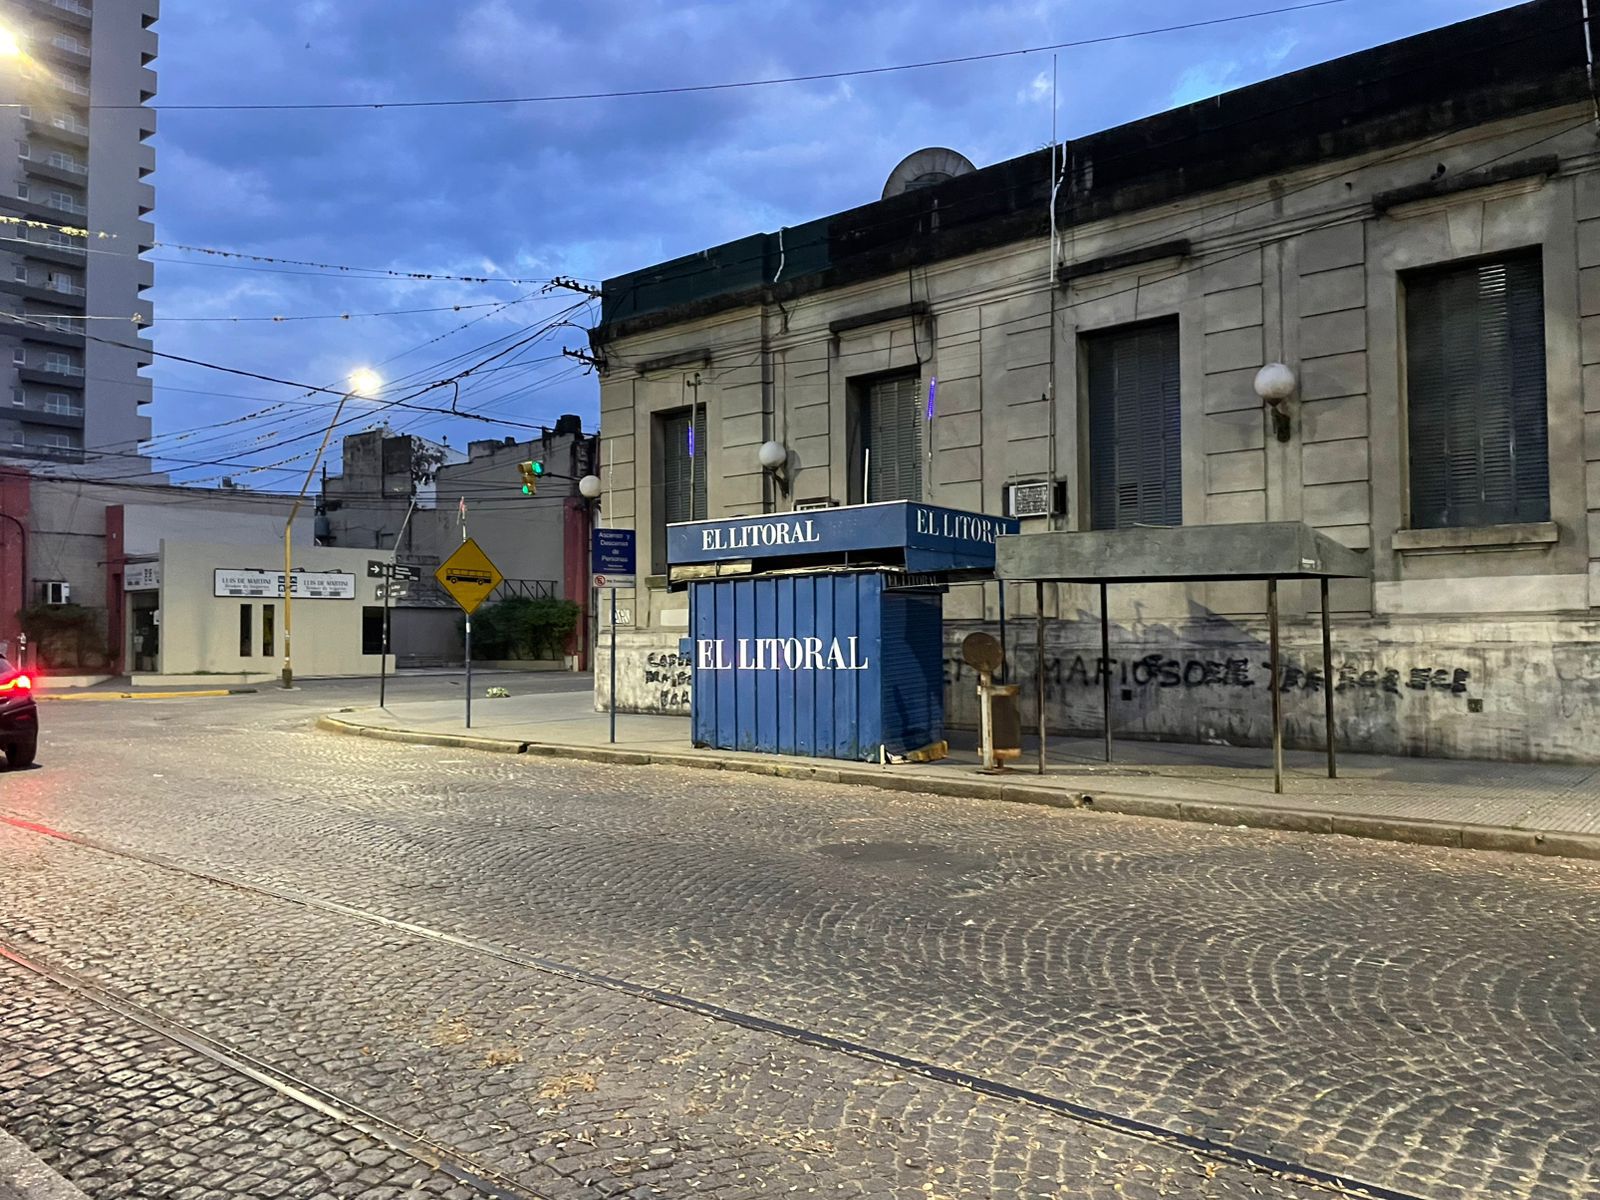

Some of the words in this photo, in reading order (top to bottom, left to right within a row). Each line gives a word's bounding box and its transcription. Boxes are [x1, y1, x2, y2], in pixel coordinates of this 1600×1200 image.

[702, 528, 728, 551] EL
[729, 519, 820, 549] LITORAL
[916, 508, 939, 536] EL
[697, 639, 732, 670] EL
[737, 636, 868, 671] LITORAL
